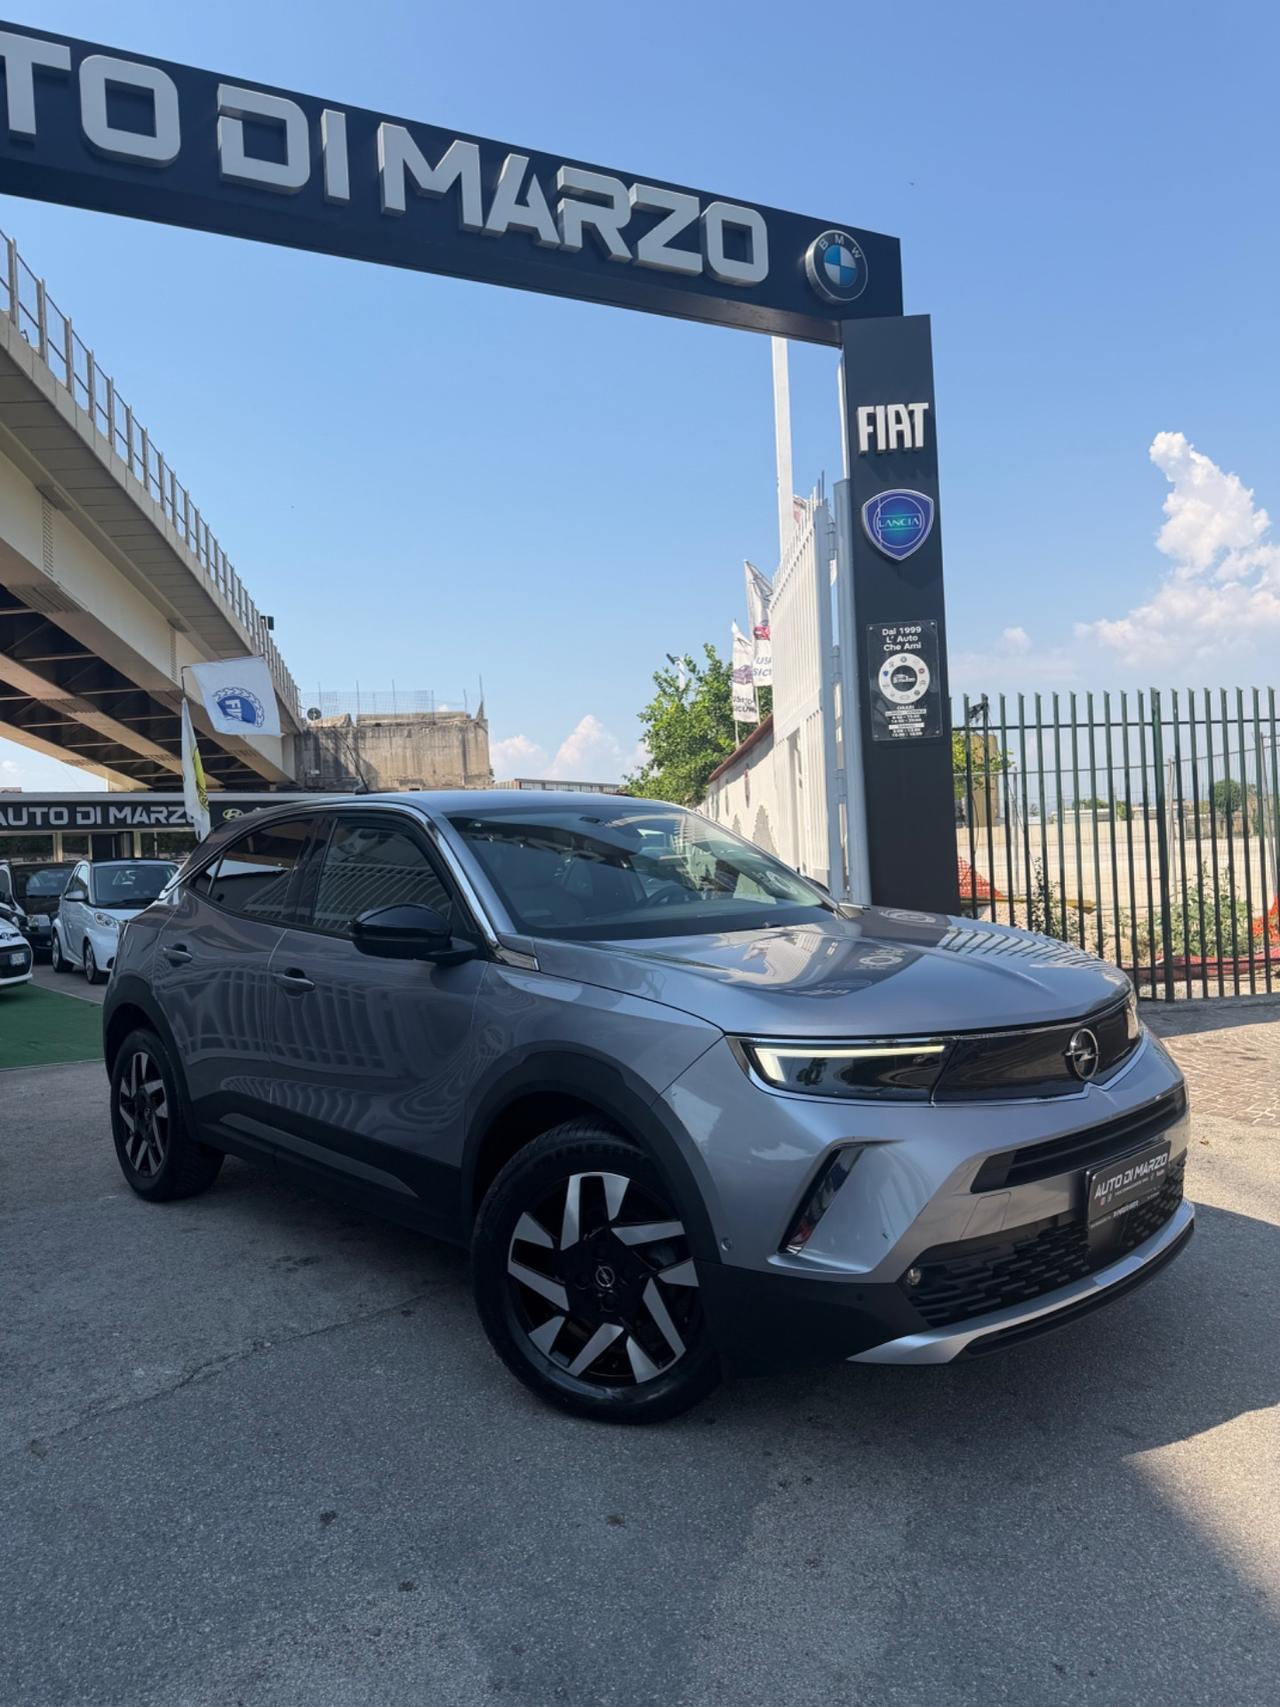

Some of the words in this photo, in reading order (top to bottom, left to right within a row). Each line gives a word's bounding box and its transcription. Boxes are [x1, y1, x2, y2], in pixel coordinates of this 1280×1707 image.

[217, 83, 350, 205] DI
[377, 121, 770, 288] MARZO
[818, 233, 862, 259] BMW
[857, 402, 929, 452] FIAT
[878, 517, 920, 528] LANCIA
[897, 635, 918, 643] Auto
[899, 626, 921, 635] 1999
[883, 643, 901, 651] Che
[904, 642, 921, 650] Ami
[76, 806, 101, 825] DI
[1094, 1174, 1122, 1199] AUTO
[1123, 1168, 1134, 1185] DI
[1133, 1153, 1168, 1177] MARZO
